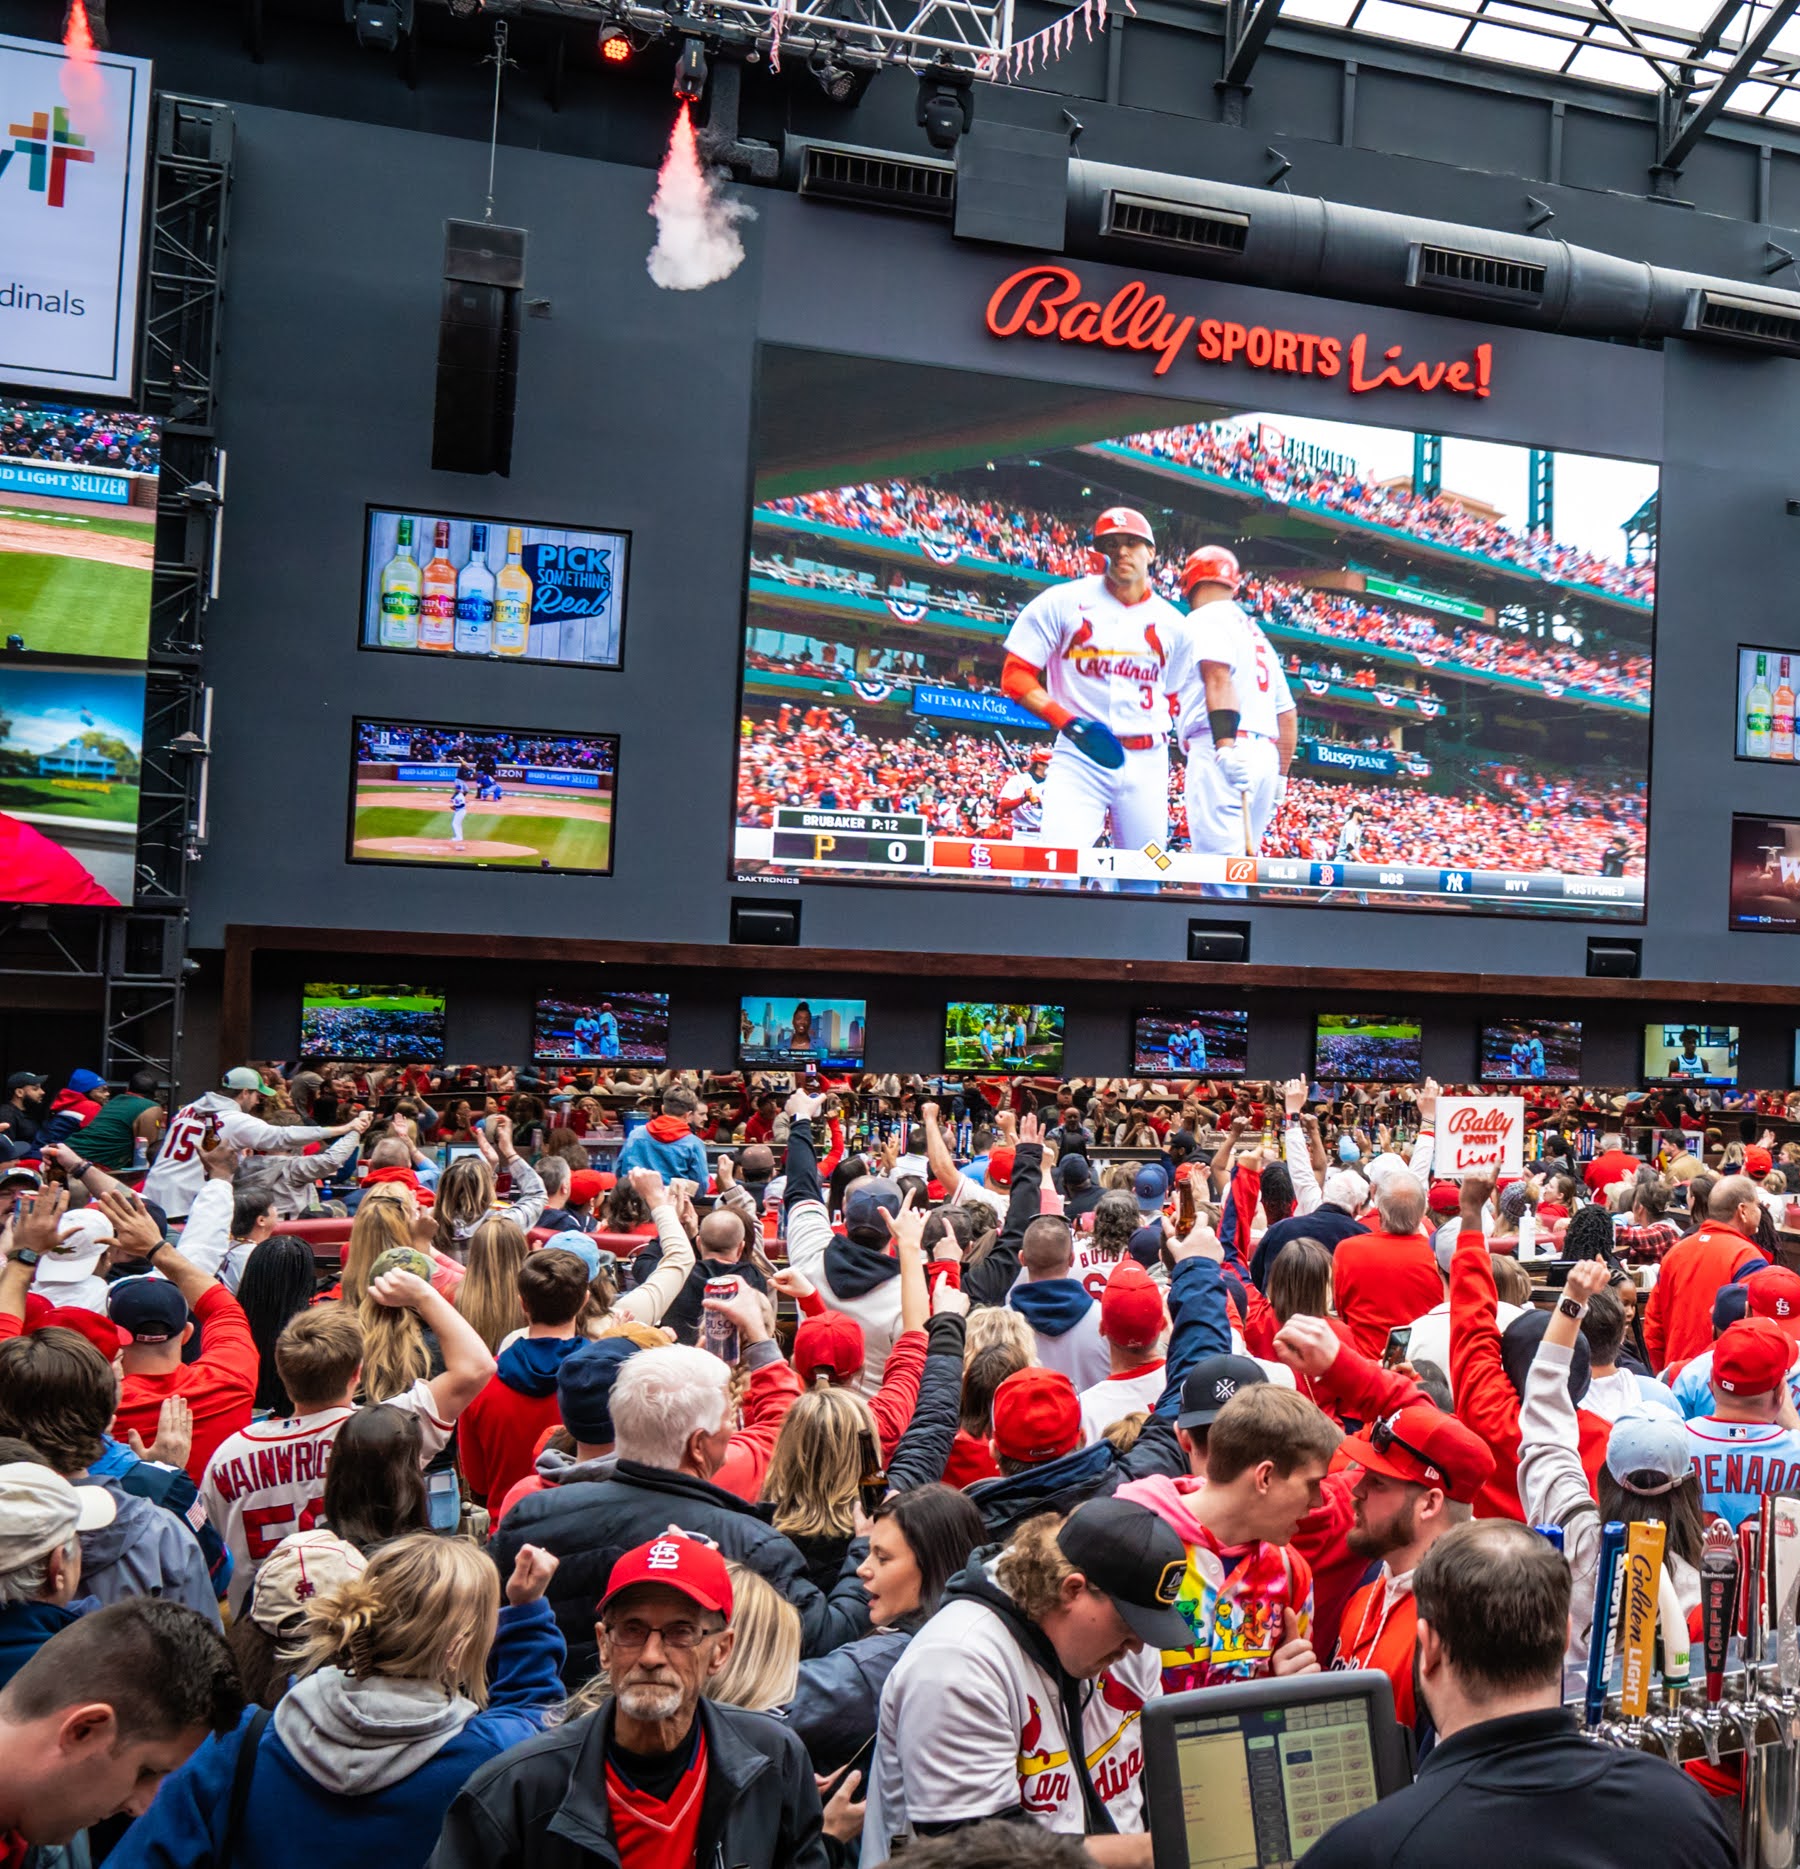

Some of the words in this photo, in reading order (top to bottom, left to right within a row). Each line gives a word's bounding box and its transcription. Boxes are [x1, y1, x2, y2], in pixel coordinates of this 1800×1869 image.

[986, 265, 1195, 374] Bally
[1199, 319, 1342, 378] SPORTS
[1349, 332, 1493, 398] Live!
[0, 467, 15, 481] D
[17, 470, 71, 487] LIGHT
[71, 474, 127, 497] SELTZER
[536, 545, 611, 574] PICK
[536, 567, 611, 590] SOMETHING
[533, 584, 612, 617] Real
[1074, 653, 1160, 682] Cardinals
[920, 692, 981, 710] SITEMAN
[981, 696, 1008, 715] Kids
[1138, 684, 1154, 711] 3
[802, 814, 866, 831] BRUBAKER
[871, 819, 899, 832] P:12
[813, 835, 836, 861] P
[887, 841, 908, 863] 0
[1043, 850, 1057, 871] 1
[737, 875, 800, 885] DAKTRONICS
[1268, 865, 1298, 880] MLB
[1379, 872, 1405, 886] BOS
[1504, 879, 1530, 893] NYY
[1565, 882, 1626, 898] POSTPONED
[1448, 1107, 1515, 1140] Bally
[163, 1122, 204, 1164] 15
[1462, 1133, 1498, 1146] SPORTS
[1456, 1145, 1506, 1170] Live!
[212, 1439, 334, 1504] WAINWRIG
[1701, 1570, 1736, 1580] Budweiser
[1630, 1553, 1653, 1648] Golden
[1708, 1580, 1725, 1668] SELECT
[1625, 1647, 1644, 1707] LIGHT
